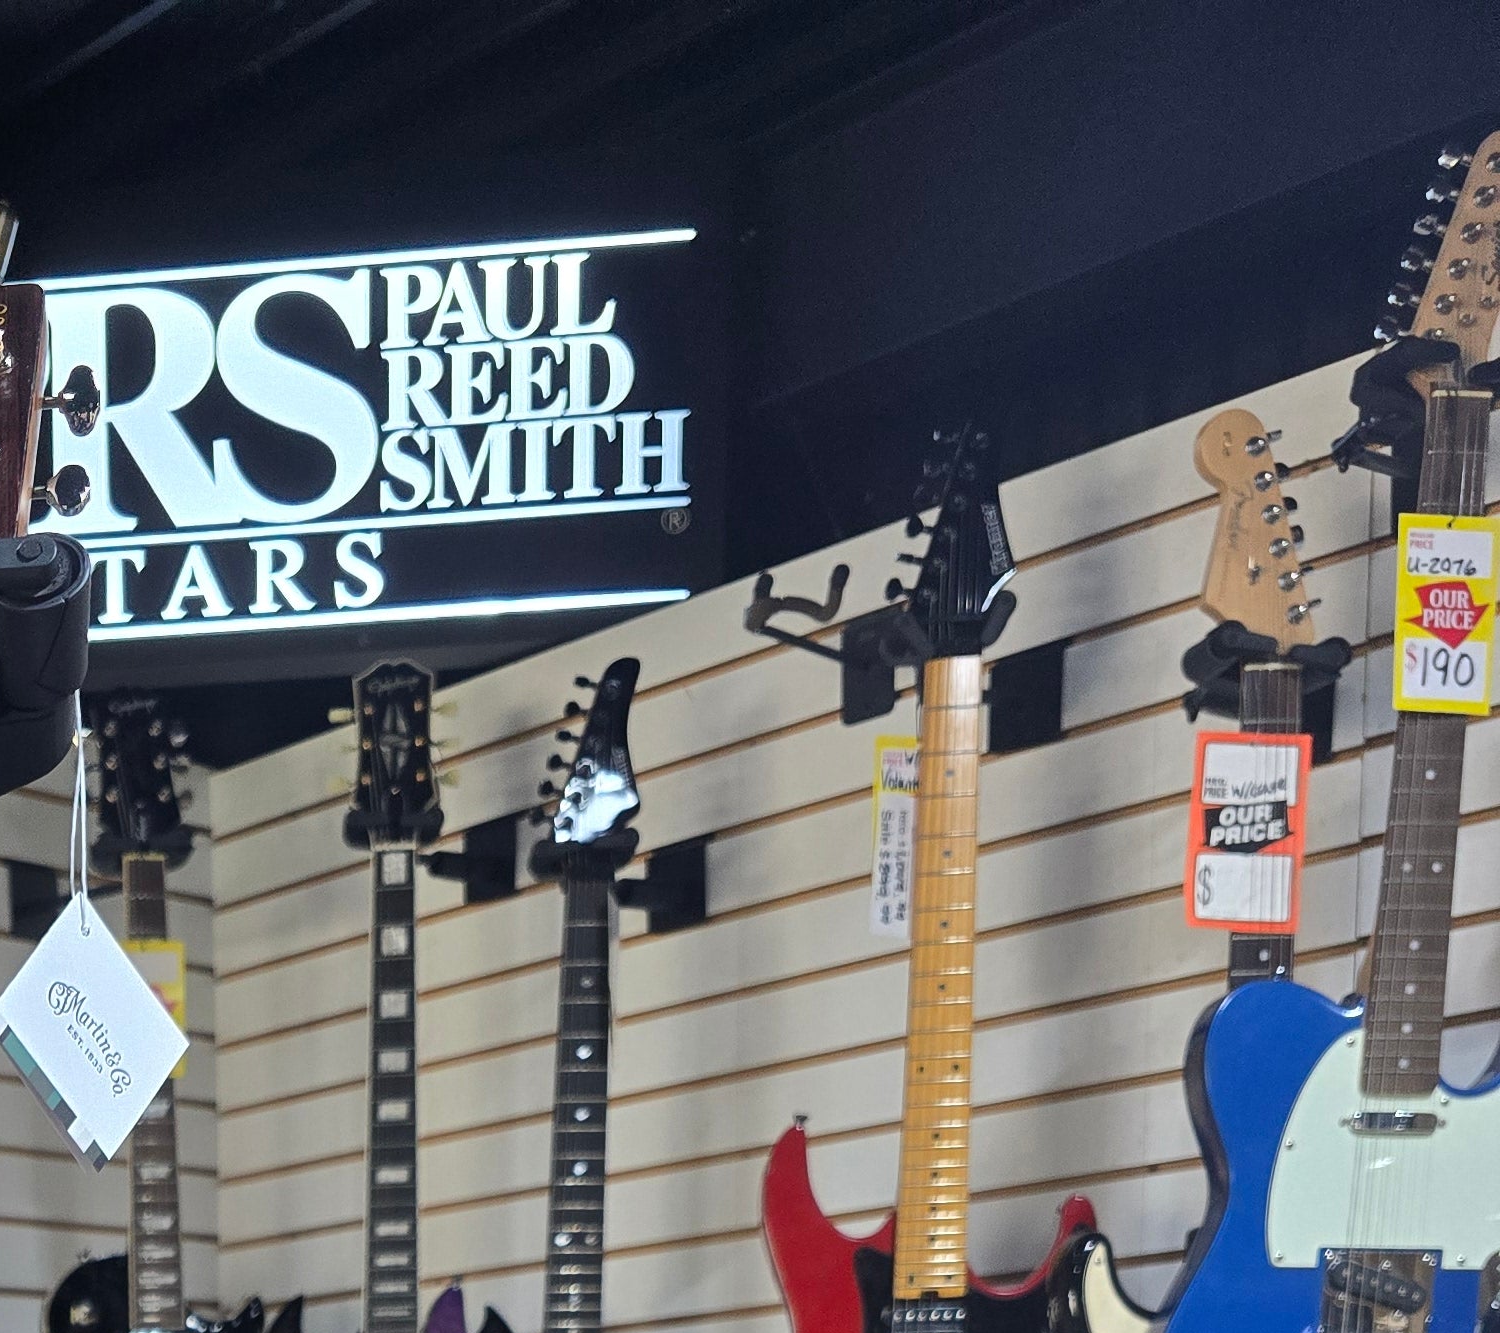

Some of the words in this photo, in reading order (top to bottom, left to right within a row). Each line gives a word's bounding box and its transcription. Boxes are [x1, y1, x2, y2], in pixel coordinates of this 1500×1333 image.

[381, 252, 616, 349] PAUL
[30, 266, 380, 533] RS
[381, 333, 635, 430] REED
[379, 408, 691, 512] SMITH
[91, 531, 385, 624] TARS
[1429, 588, 1470, 609] OUR
[1422, 608, 1475, 630] PRICE
[1210, 819, 1286, 847] PRICE
[1219, 804, 1273, 826] OUR
[1197, 864, 1212, 906] $
